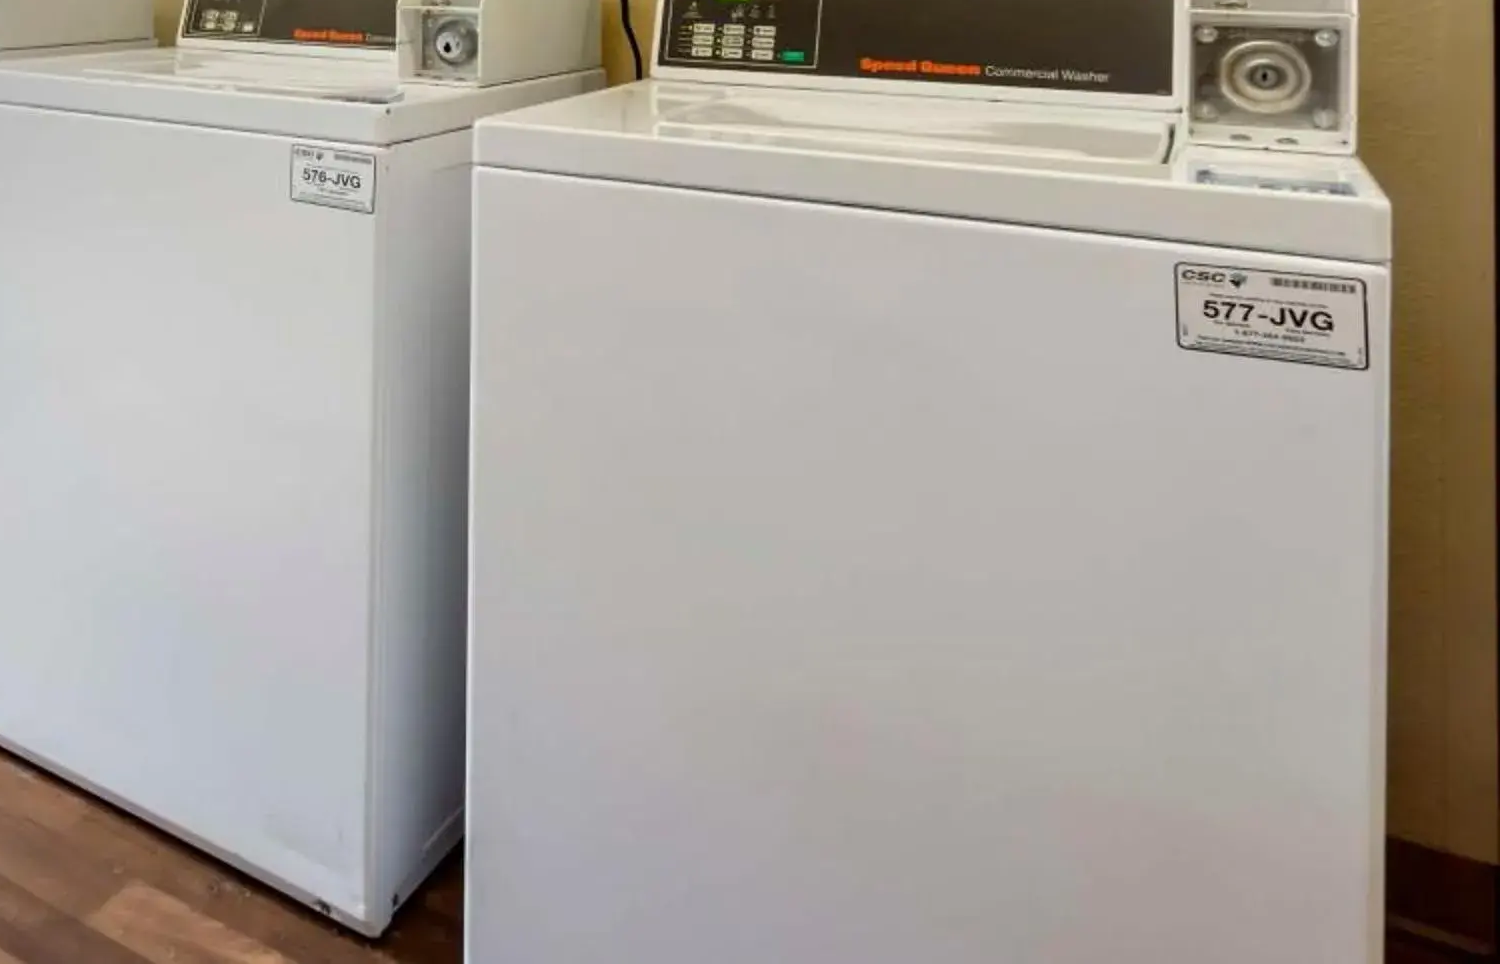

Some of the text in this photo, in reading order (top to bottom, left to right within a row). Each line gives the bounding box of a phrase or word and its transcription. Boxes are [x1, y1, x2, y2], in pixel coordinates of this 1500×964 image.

[860, 57, 1109, 83] Speed Queen Commercial Washer
[302, 167, 362, 189] 576-JVG
[1203, 299, 1334, 332] 577-JVG
